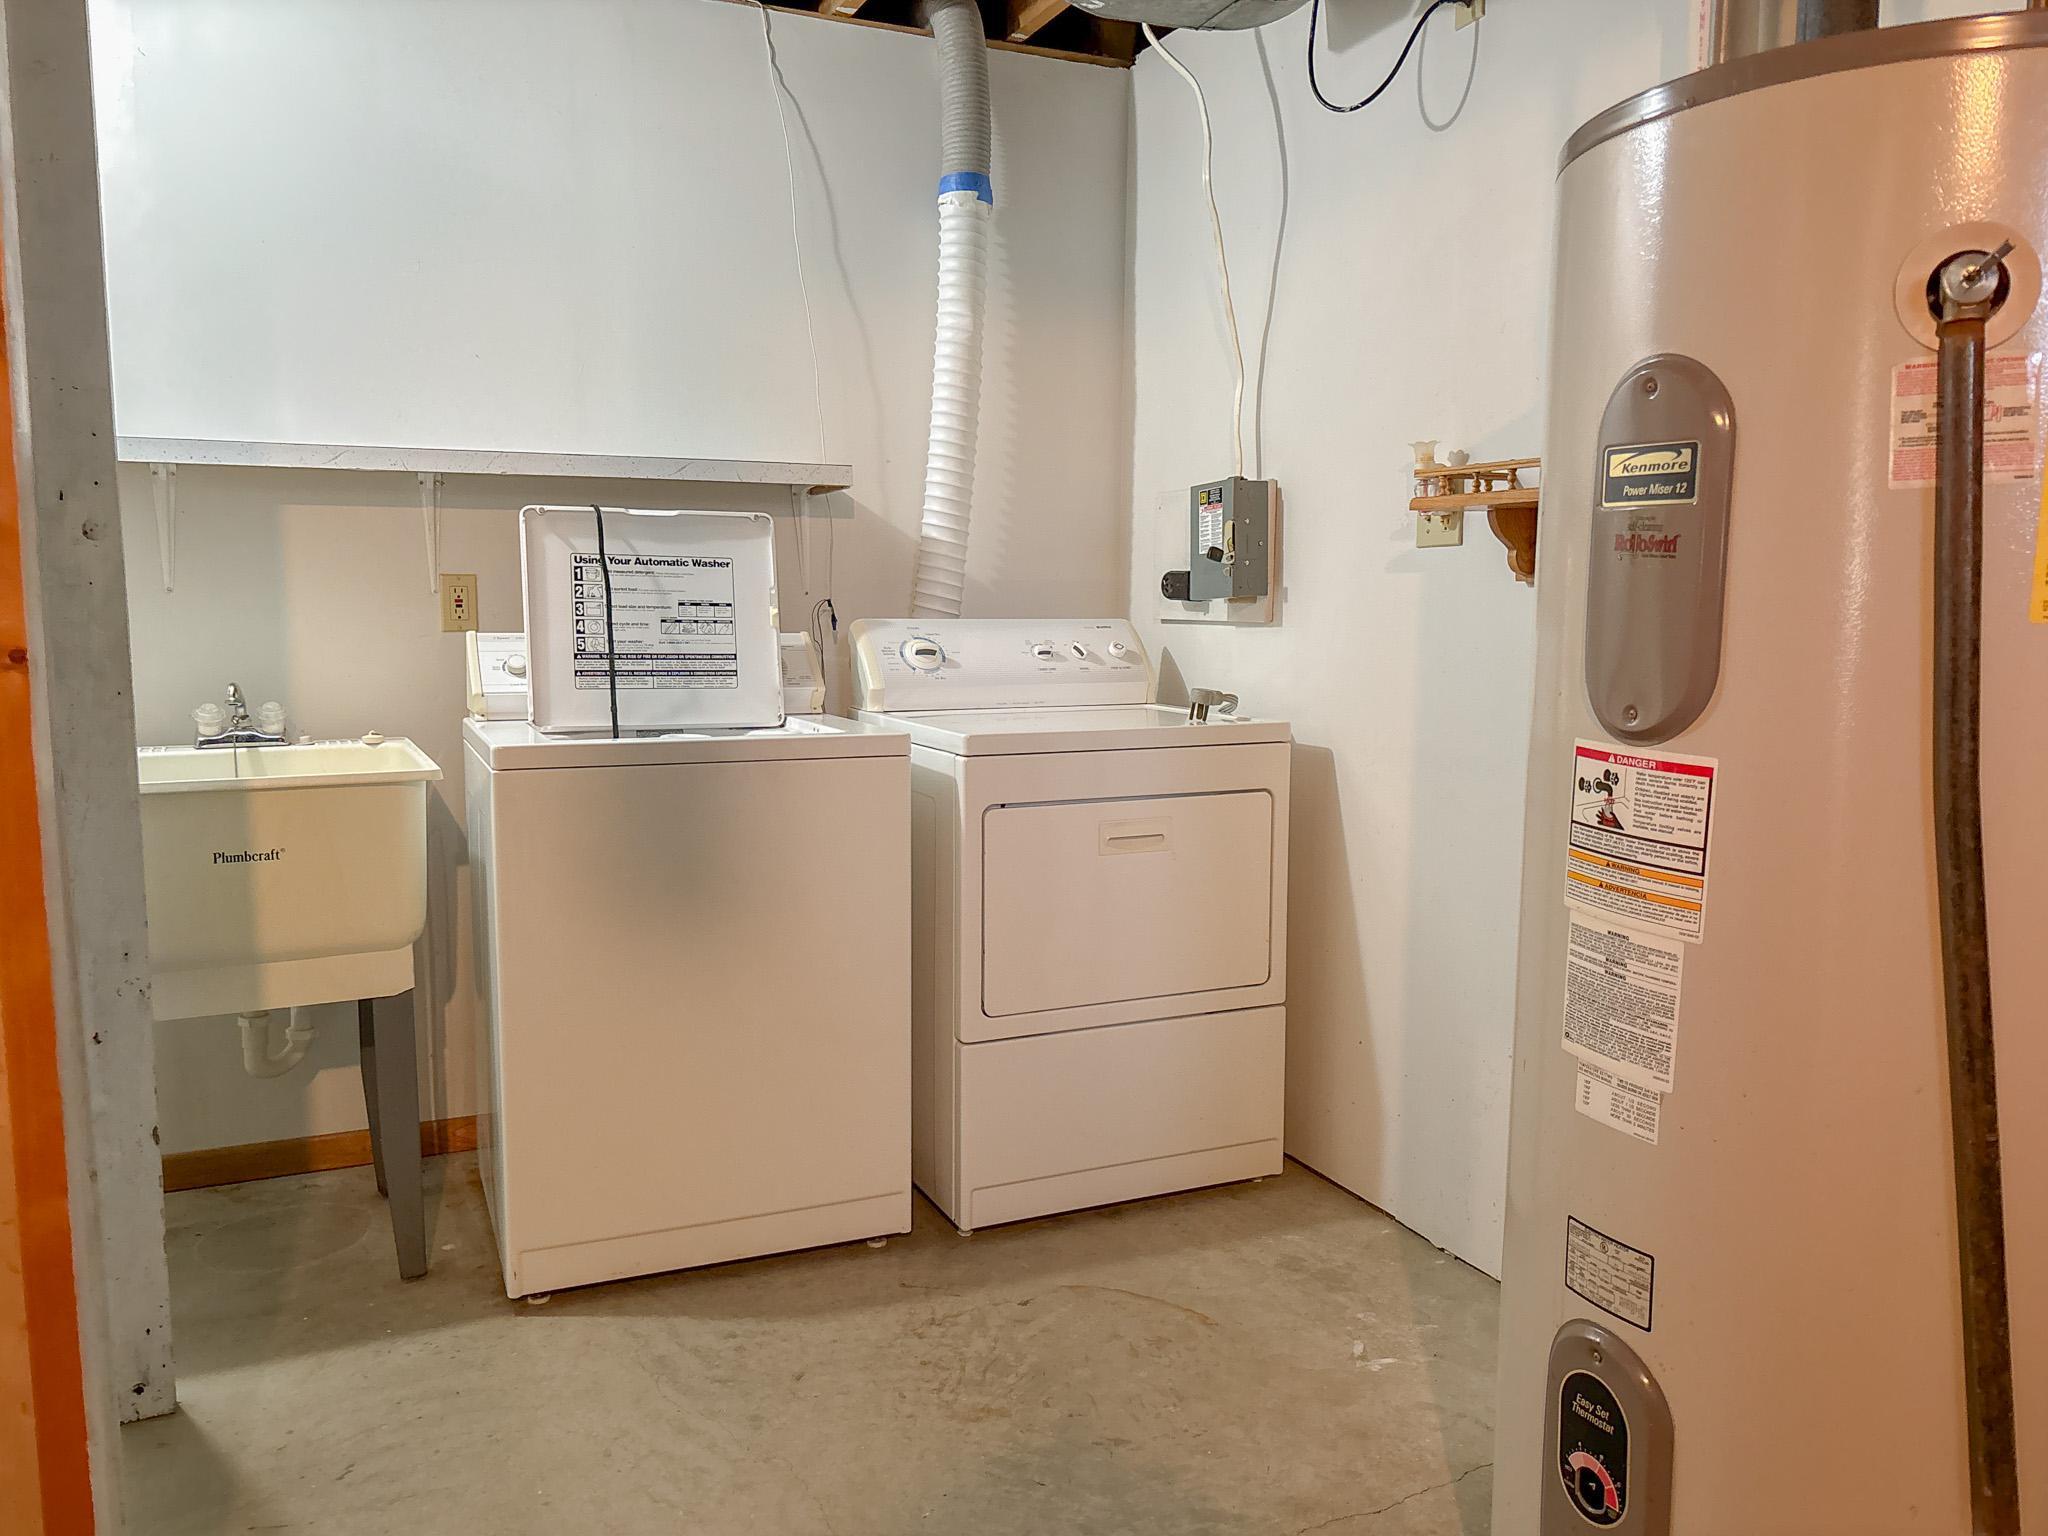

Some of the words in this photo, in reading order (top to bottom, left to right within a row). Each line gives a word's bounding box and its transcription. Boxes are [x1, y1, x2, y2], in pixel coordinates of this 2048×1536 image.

[1622, 460, 1688, 474] Kenmore
[1622, 485, 1648, 497] Power
[1648, 483, 1674, 495] Miser
[1675, 482, 1688, 494] 12
[574, 556, 602, 566] Using
[608, 556, 632, 565] Your
[634, 557, 689, 567] Automatic
[692, 558, 730, 568] Washer
[574, 568, 582, 580] 1
[575, 585, 583, 598] 2
[576, 603, 584, 615] 3
[576, 620, 584, 632] 4
[577, 638, 585, 650] 5
[1616, 755, 1656, 770] DANGER
[213, 848, 280, 864] Plumbcraft
[1611, 862, 1640, 875] WARNING
[1605, 883, 1648, 900] ADVERTENCIA
[1607, 930, 1630, 941] WARNING
[1606, 958, 1628, 968] WARNING
[1605, 970, 1626, 980] WARNING
[1576, 1392, 1594, 1413] Easy
[1595, 1405, 1609, 1421] Set
[1572, 1400, 1614, 1435] Thermostat
